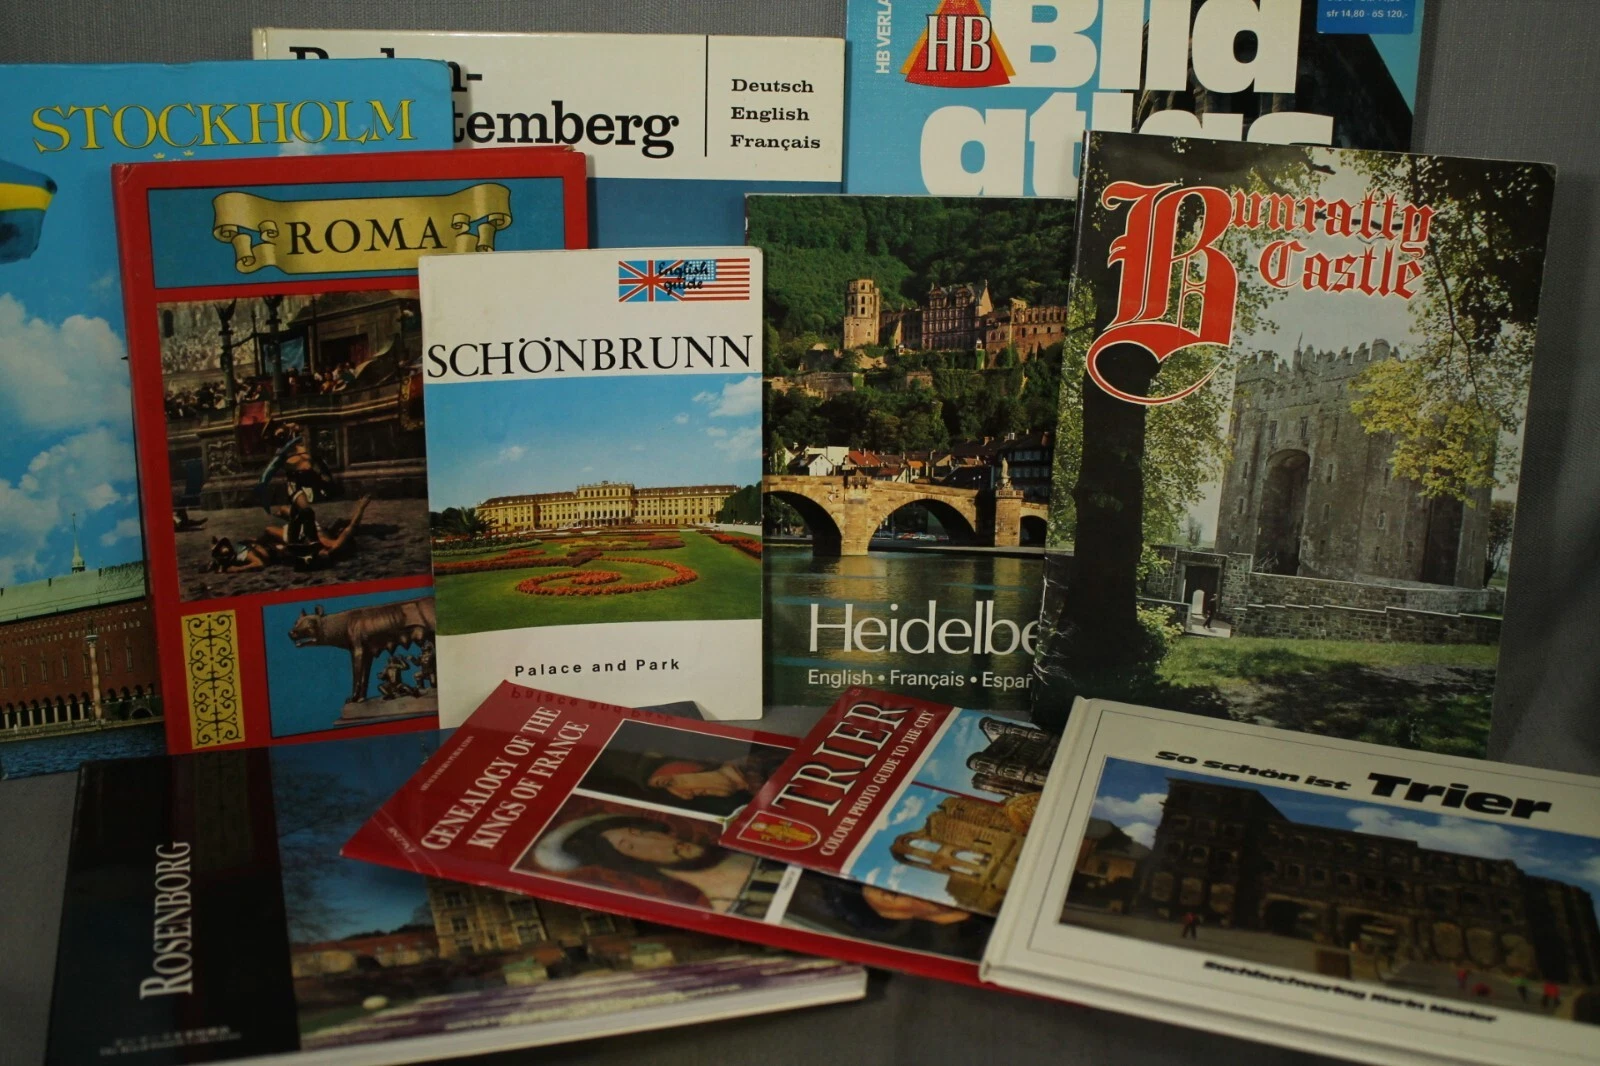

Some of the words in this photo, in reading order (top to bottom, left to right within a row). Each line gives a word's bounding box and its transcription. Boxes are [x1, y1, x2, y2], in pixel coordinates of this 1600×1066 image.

[1326, 9, 1339, 18] sfr
[1341, 9, 1365, 19] 14,80
[876, 50, 891, 74] HB
[926, 14, 992, 72] HB
[731, 78, 814, 94] Deutsch
[31, 99, 417, 153] STOCKHOLM
[730, 106, 810, 123] English
[730, 134, 821, 151] Français
[285, 216, 448, 256] ROMA
[657, 260, 710, 281] English
[663, 277, 704, 296] guide
[1258, 239, 1424, 300] Castle
[1086, 180, 1437, 405] Bunratty
[427, 334, 754, 379] SCHÖNBRUNN
[514, 662, 582, 677] Palace
[592, 659, 627, 674] and
[635, 658, 681, 672] Park
[808, 668, 873, 688] English
[890, 670, 965, 689] Français
[421, 756, 519, 850] GENEALOGY
[504, 735, 536, 756] OF
[520, 706, 562, 735] THE
[771, 703, 909, 816] TRIER
[466, 800, 527, 850] KINGS
[510, 777, 544, 800] OF
[527, 721, 590, 778] FRANCE
[820, 816, 859, 856] COLOUR
[848, 784, 881, 816] PHOTO
[872, 757, 900, 784] GUIDE
[891, 745, 909, 758] TO
[900, 728, 922, 744] THE
[914, 709, 936, 729] CITY
[1155, 750, 1198, 765] So
[1202, 758, 1300, 782] schön
[1304, 775, 1352, 791] ist
[1367, 772, 1553, 820] Trier
